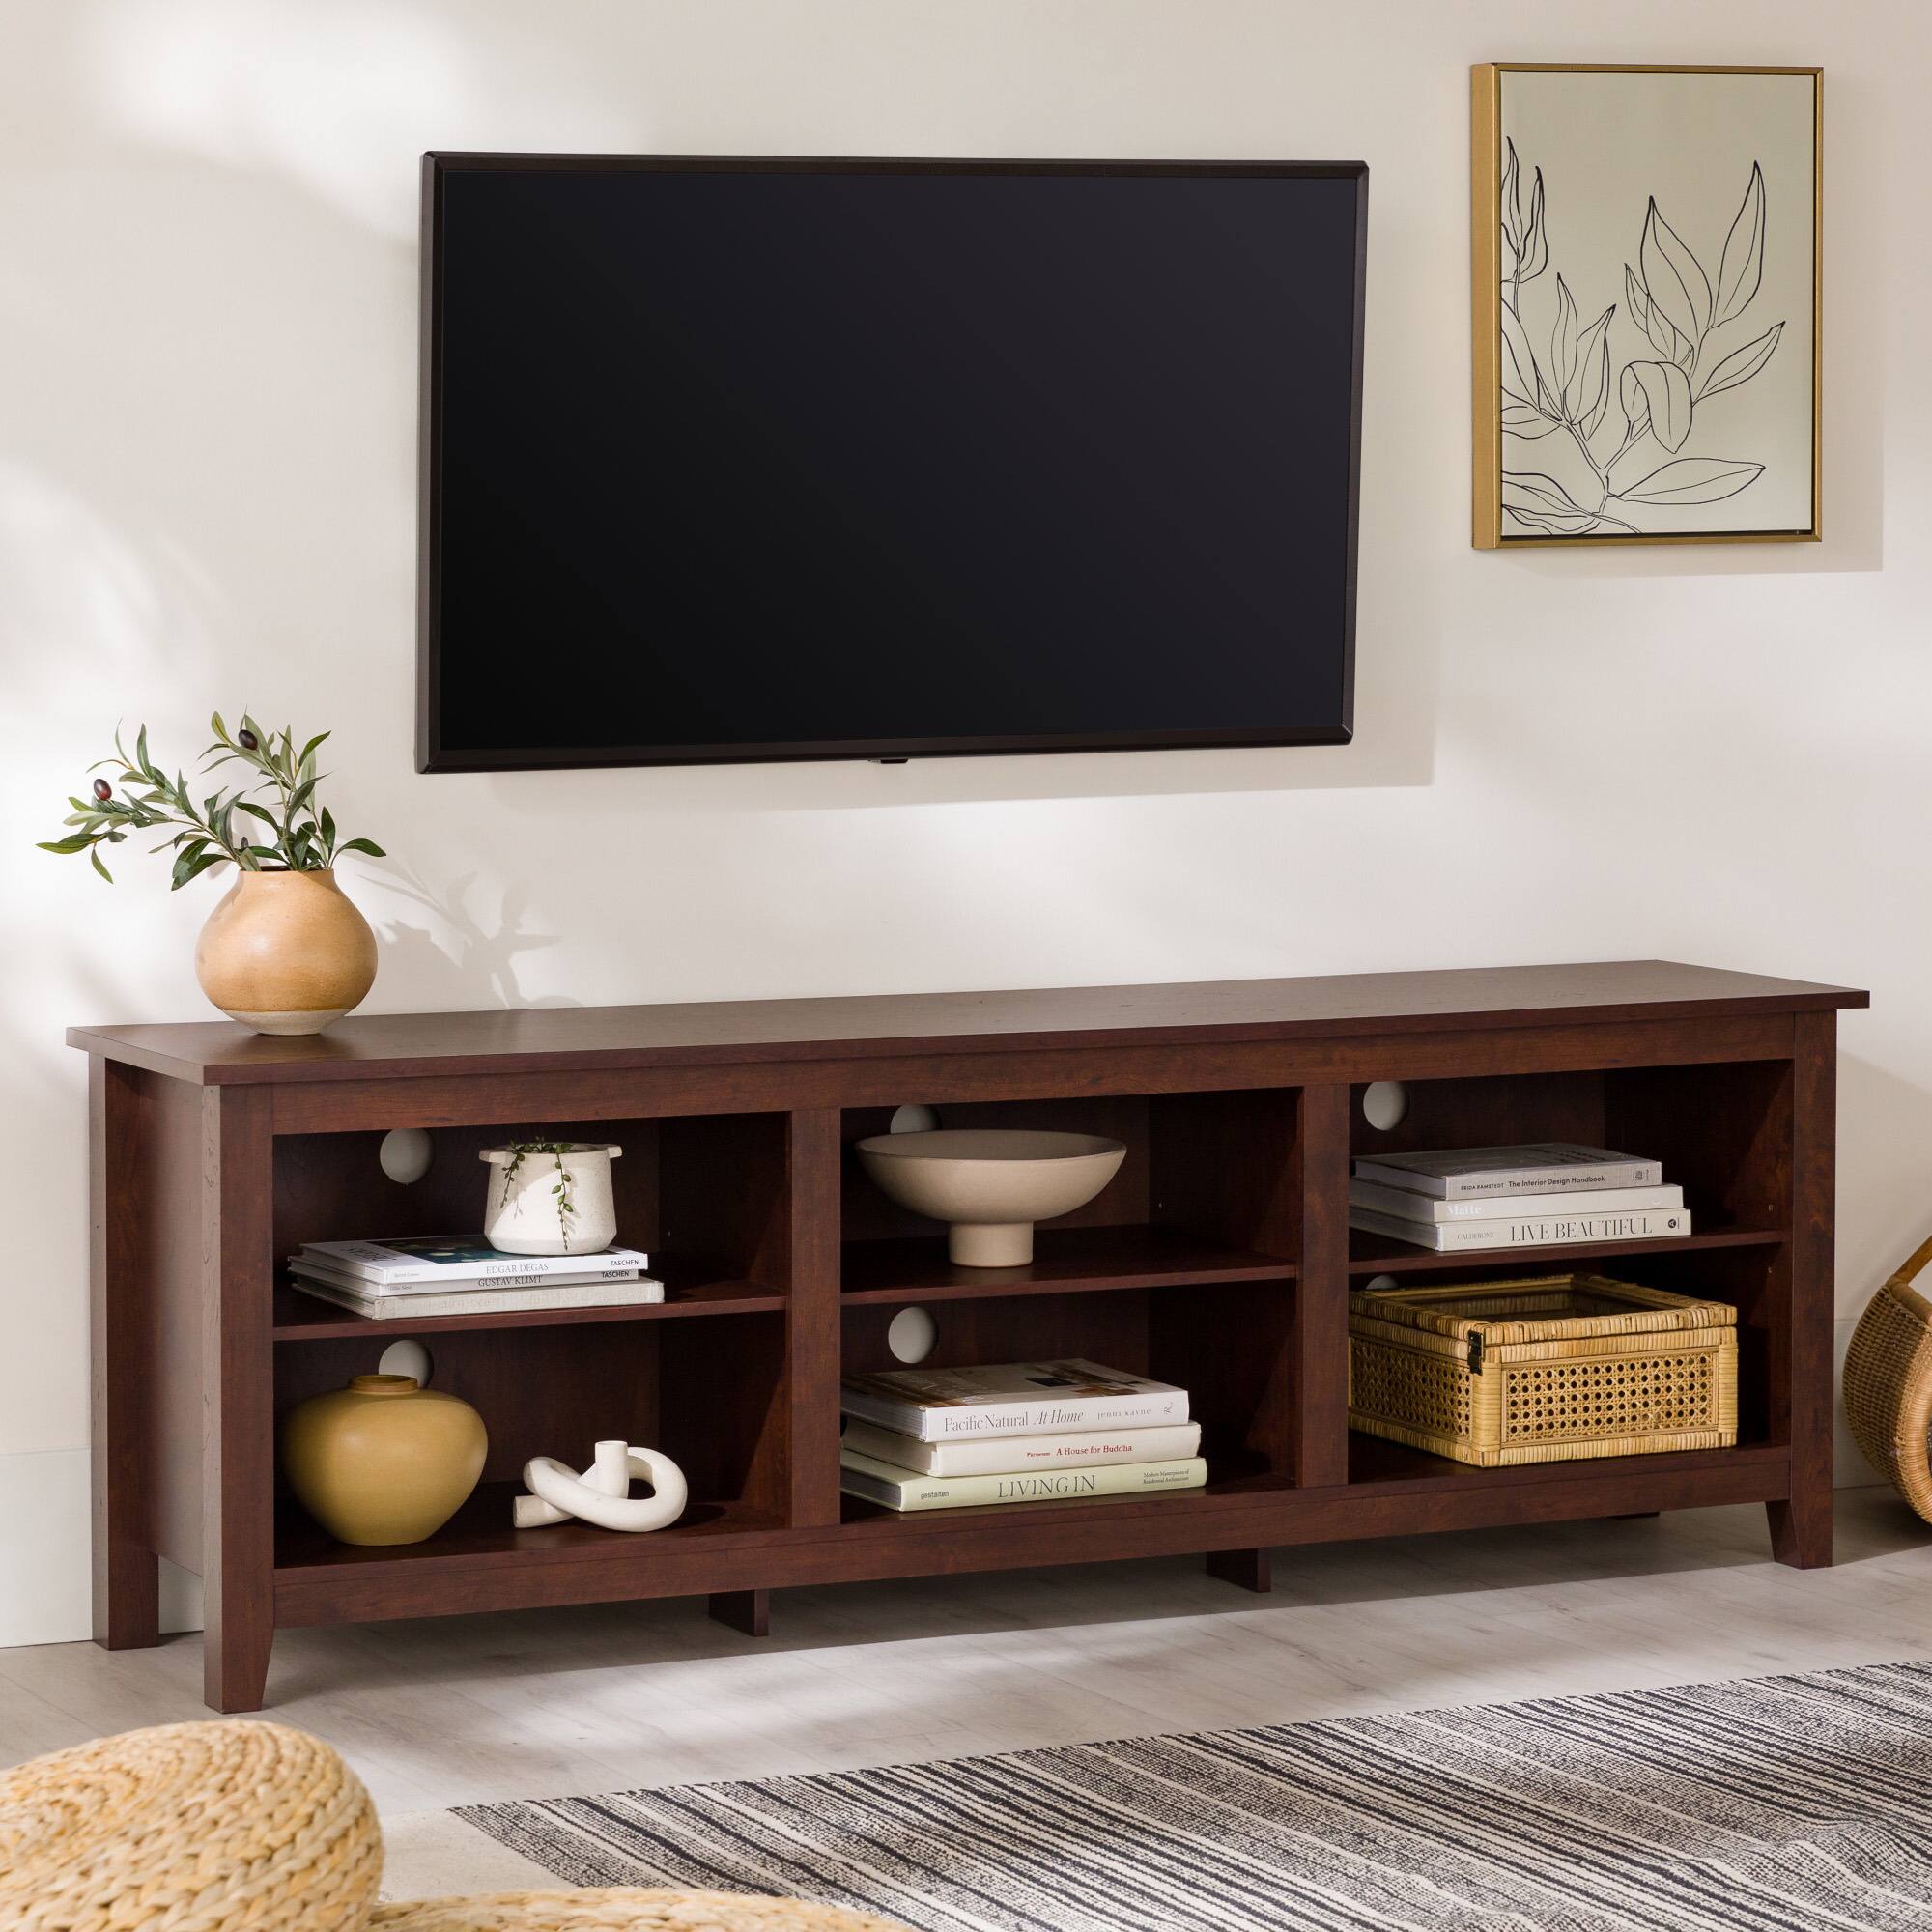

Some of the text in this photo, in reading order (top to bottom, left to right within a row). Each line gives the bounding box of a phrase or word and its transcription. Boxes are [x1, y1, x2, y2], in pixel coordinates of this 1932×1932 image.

[1548, 1177, 1571, 1186] Design
[1511, 1217, 1653, 1241] LIVE BEAUTIFUL
[486, 1263, 549, 1274] EDGAR DEGAS
[478, 1275, 543, 1287] GUSTAV KLIMT
[945, 1409, 1084, 1432] Pacific Natural At Home
[1103, 1444, 1132, 1453] Buddha
[998, 1474, 1095, 1498] LIVING IN
[921, 1491, 949, 1499] gestalten
